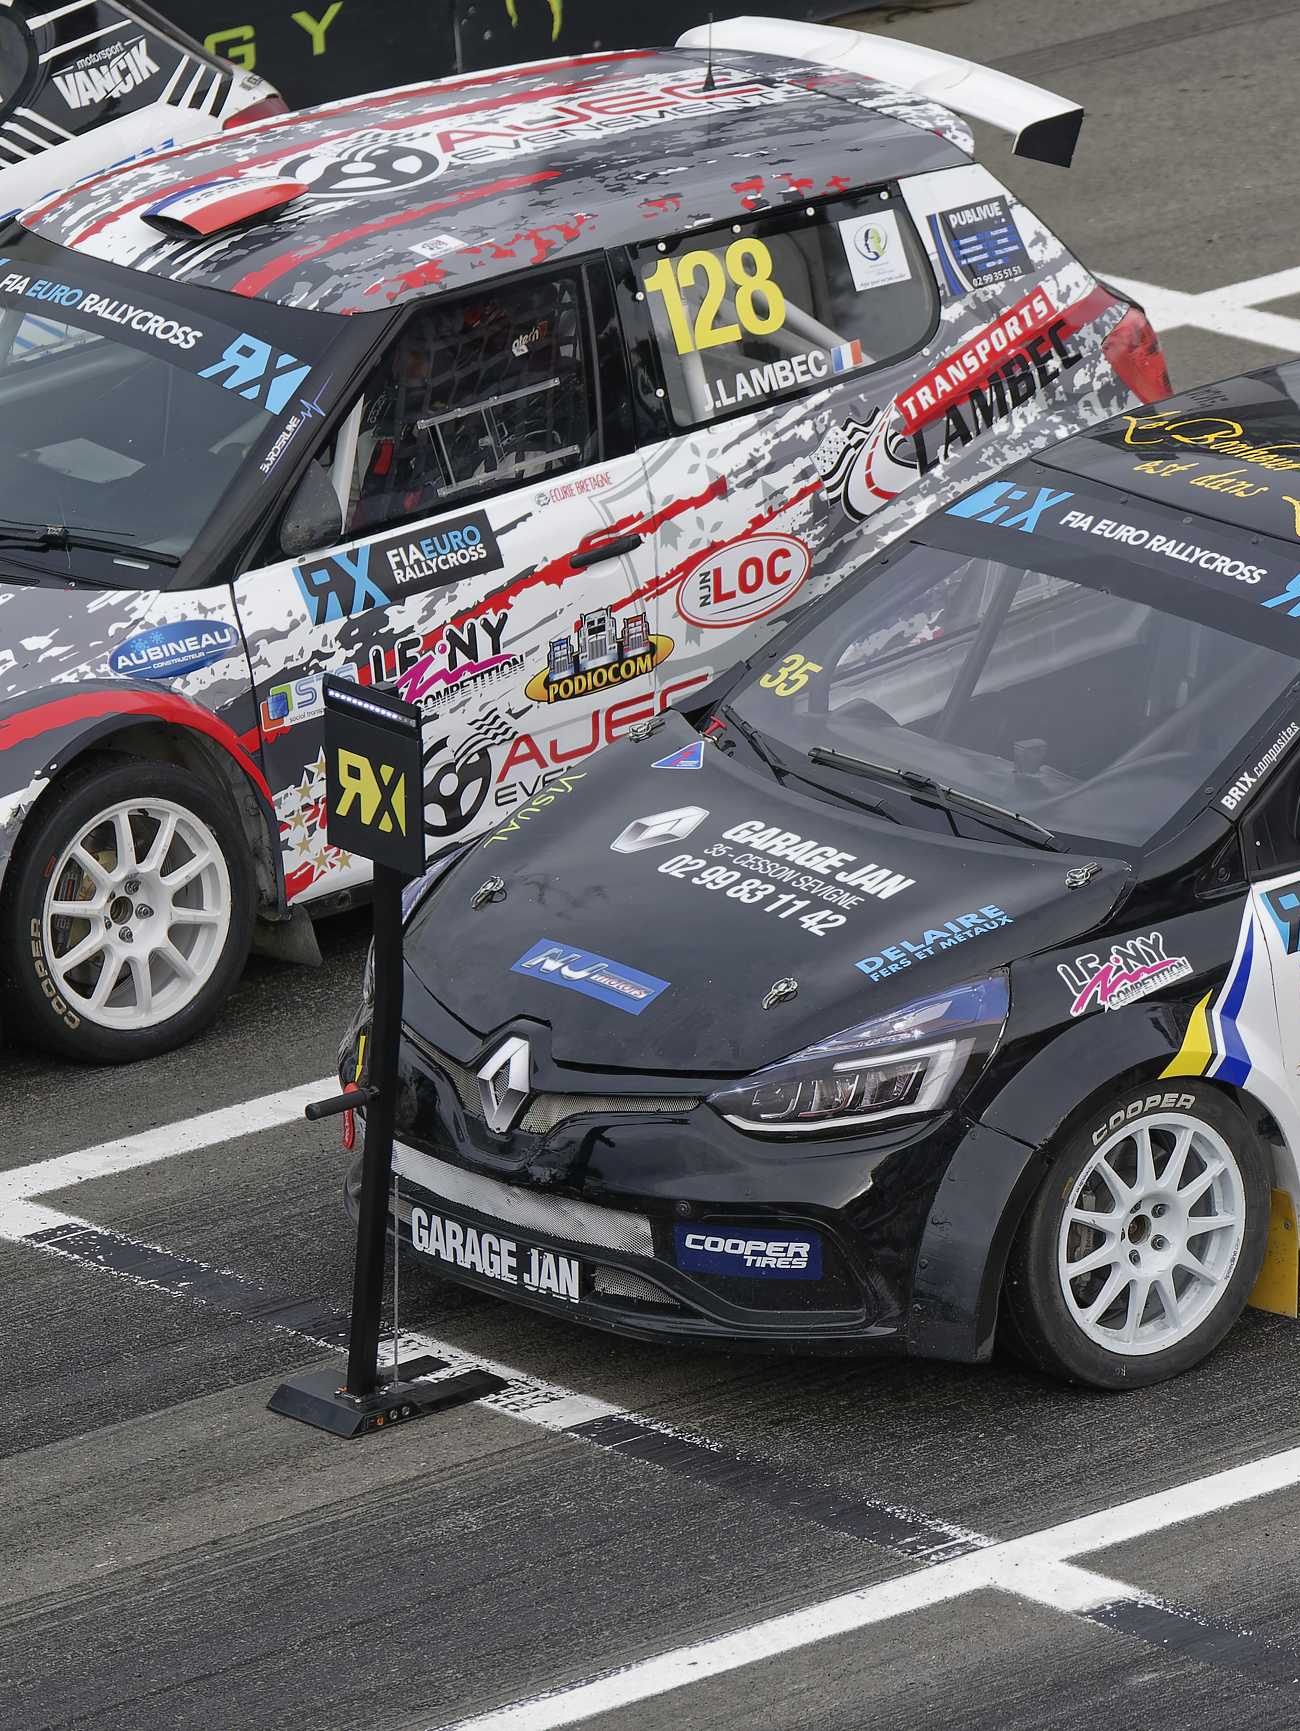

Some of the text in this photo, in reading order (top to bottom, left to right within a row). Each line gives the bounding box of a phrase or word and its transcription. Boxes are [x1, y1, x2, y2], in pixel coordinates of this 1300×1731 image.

[76, 41, 124, 71] motorsport
[949, 201, 1004, 228] PUBLIVUE
[644, 238, 786, 355] 128
[972, 265, 1022, 287] 02 99 35 51 51
[0, 273, 203, 350] FIA EURO RALLYCROSS
[703, 350, 828, 411] J.LAMBEC
[902, 295, 1052, 420] TRANSPORTS
[913, 319, 1083, 476] LAMBEC
[549, 472, 612, 503] ECURIE BRETAGNE
[1190, 469, 1269, 497] dans
[392, 543, 487, 585] RALLYCROSS
[713, 547, 792, 604] LOC
[1059, 510, 1268, 585] FIA EURO RALLYCROSS
[117, 628, 231, 670] AUBINEAU
[153, 652, 206, 669] CONSTRUCTEUR
[760, 654, 823, 696] 35
[412, 654, 525, 710] COMPETITION
[549, 656, 652, 702] PODIOCOM
[336, 748, 406, 837] RX
[1221, 721, 1300, 810] BRIX composites
[484, 772, 587, 848] VISUAL
[703, 843, 732, 857] 35
[733, 853, 798, 884] CESSON
[792, 873, 865, 910] SEVIGNE
[722, 820, 916, 900] GARAGE JAN
[657, 854, 847, 936] 02 99 83 11 42
[855, 904, 1005, 974] DELAIRE
[869, 958, 912, 982] FERS
[914, 946, 935, 960] ET
[1108, 958, 1189, 1005] COMPETITION
[1091, 1093, 1196, 1146] COOPER
[411, 1207, 580, 1303] GARAGE JAN
[685, 1233, 810, 1257] COOPER
[743, 1255, 808, 1269] TIRES
